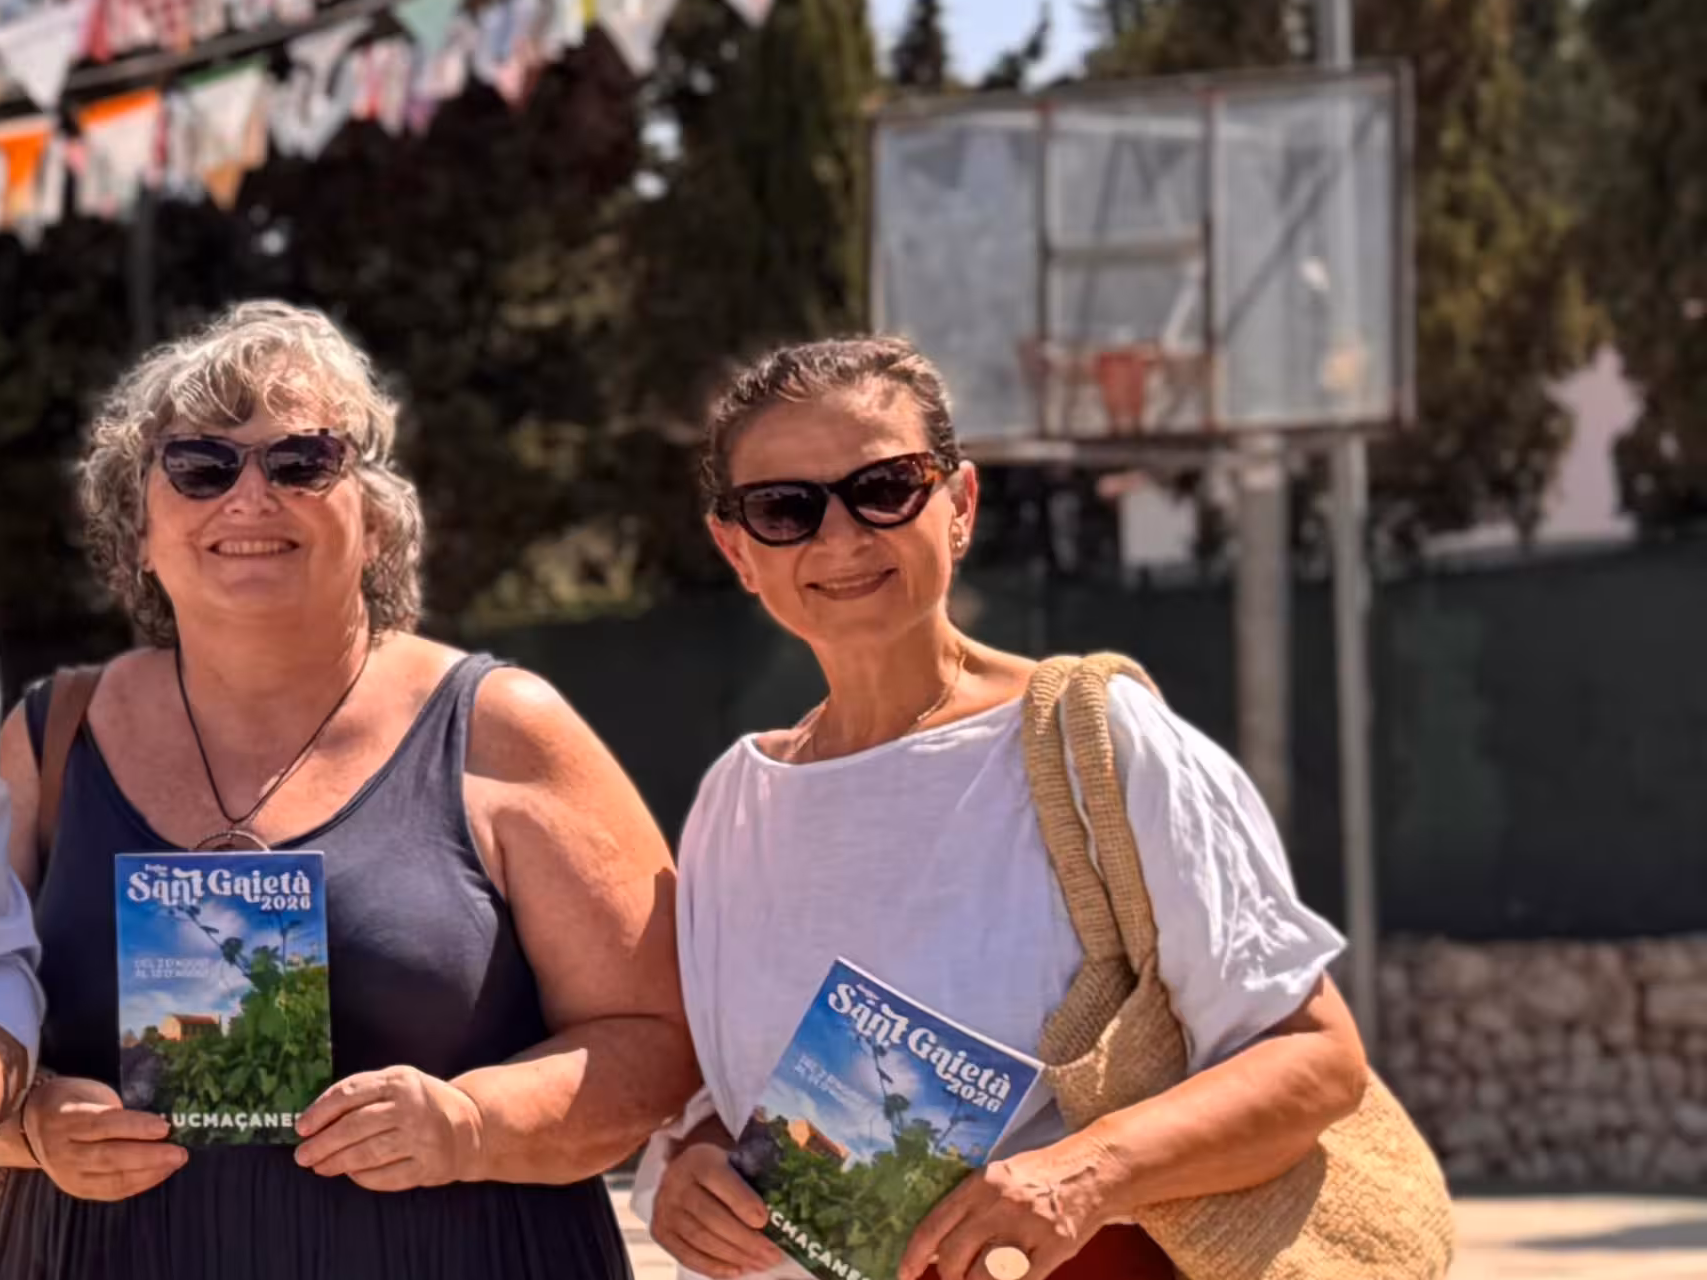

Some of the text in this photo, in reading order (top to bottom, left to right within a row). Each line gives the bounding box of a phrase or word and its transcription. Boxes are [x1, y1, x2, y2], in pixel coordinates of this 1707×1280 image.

[127, 867, 311, 907] Sant Gaietà
[828, 983, 909, 1048] Sant
[907, 1027, 1011, 1102] Gaietà
[160, 1112, 303, 1132] UCMAÇANE
